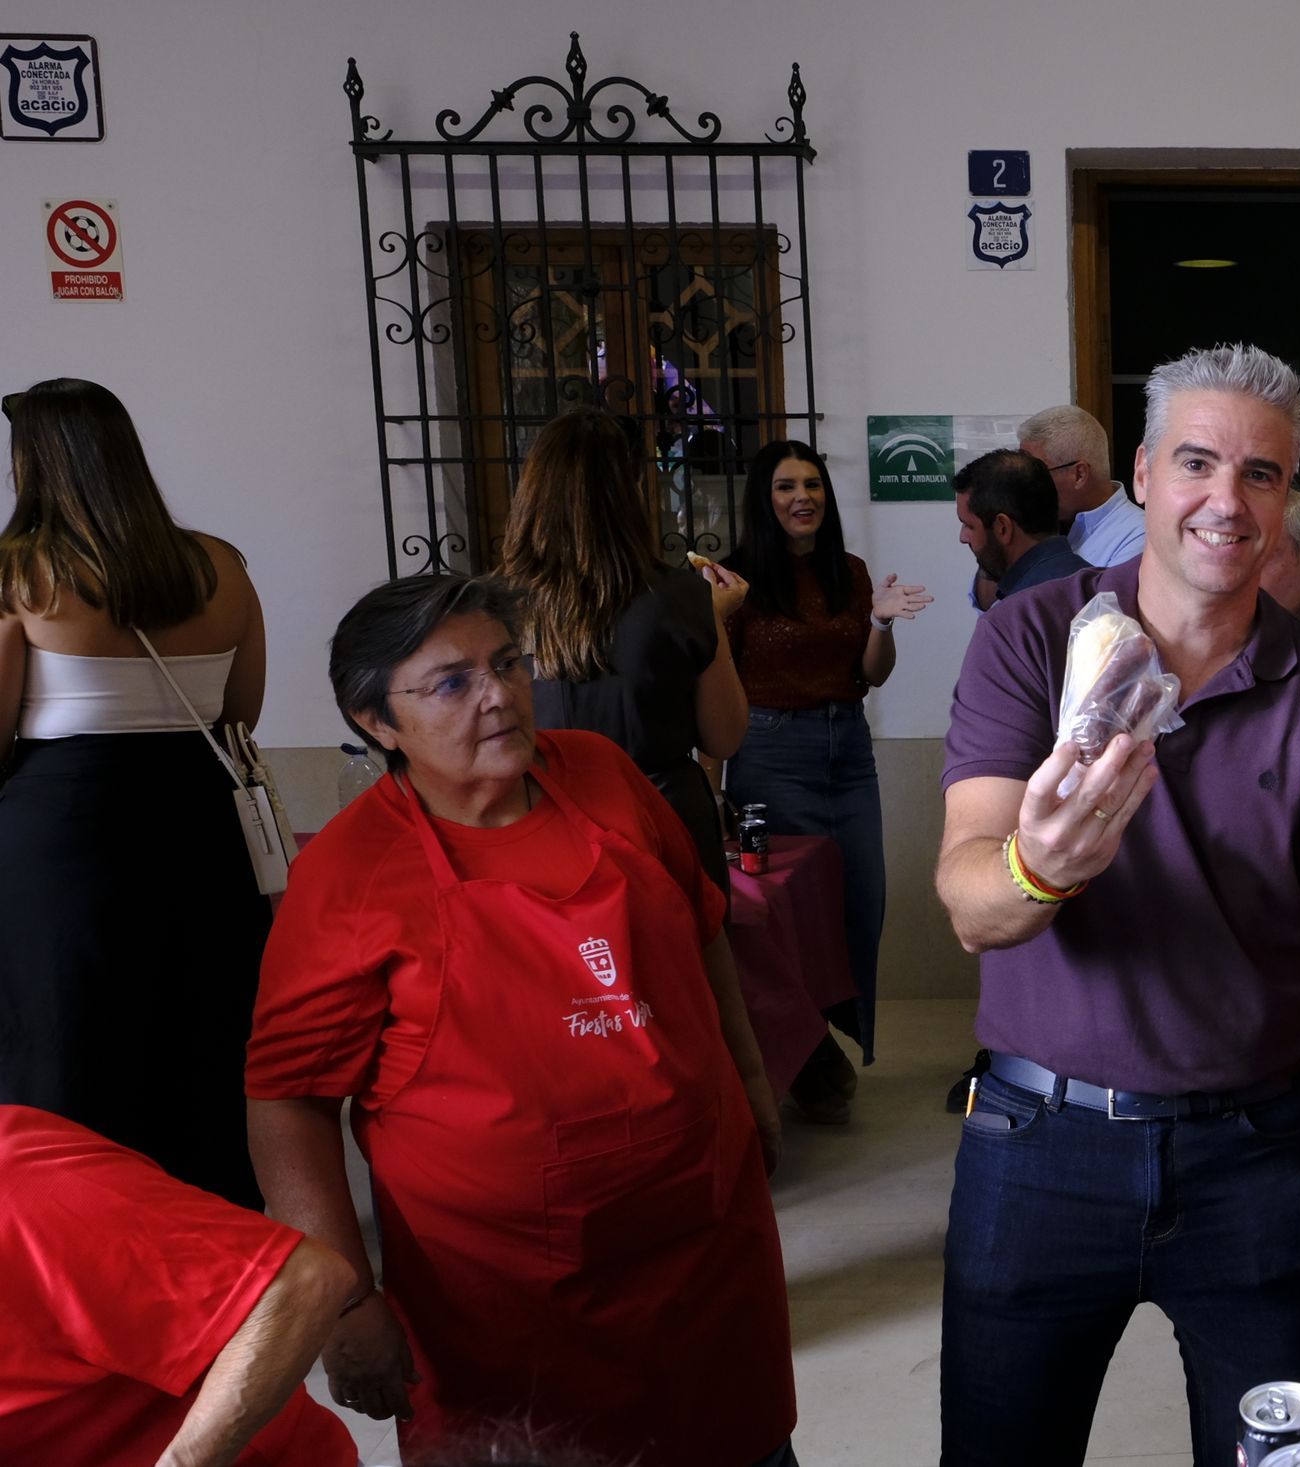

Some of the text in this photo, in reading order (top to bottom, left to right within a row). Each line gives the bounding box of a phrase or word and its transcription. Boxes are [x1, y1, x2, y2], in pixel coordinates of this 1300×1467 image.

[28, 62, 62, 70] ALARMA
[21, 70, 71, 79] CONECTADA
[20, 97, 76, 111] acacio
[992, 159, 1006, 188] 2
[981, 240, 1020, 250] acacio
[64, 275, 108, 284] PROHIBIDO
[58, 285, 118, 296] JUGAR CON BALÓN
[878, 475, 899, 483] JUNTA
[902, 475, 910, 483] DE
[562, 1010, 622, 1037] Fiestas
